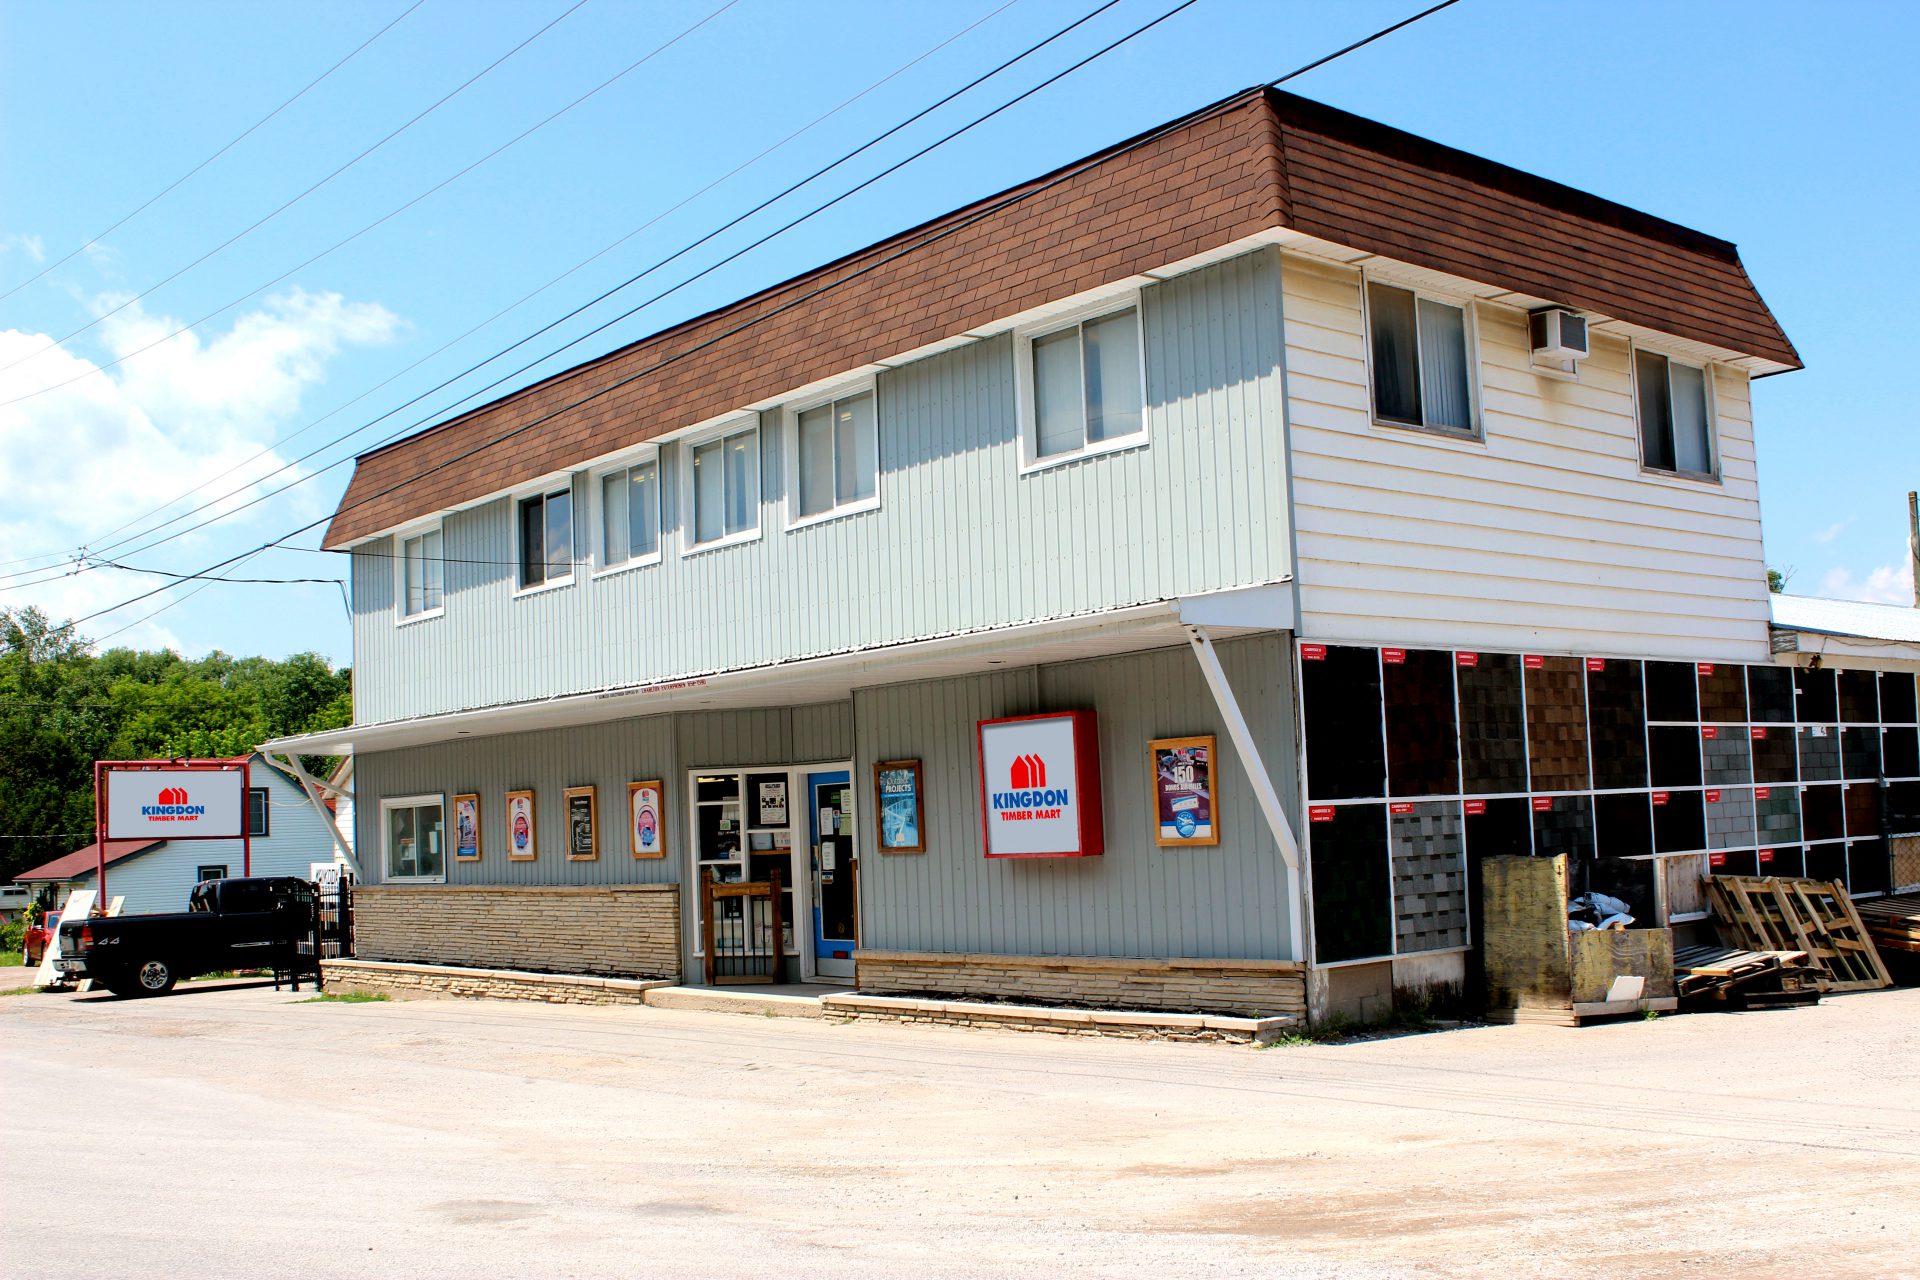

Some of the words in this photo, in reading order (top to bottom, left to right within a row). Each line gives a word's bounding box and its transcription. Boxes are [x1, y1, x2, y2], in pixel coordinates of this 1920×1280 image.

[1172, 765, 1194, 783] 150
[886, 785, 912, 793] PROJECTS
[993, 789, 1068, 809] KINGDON
[142, 806, 204, 815] KINGDON
[1001, 811, 1032, 821] TIMBER
[1036, 809, 1061, 820] MART
